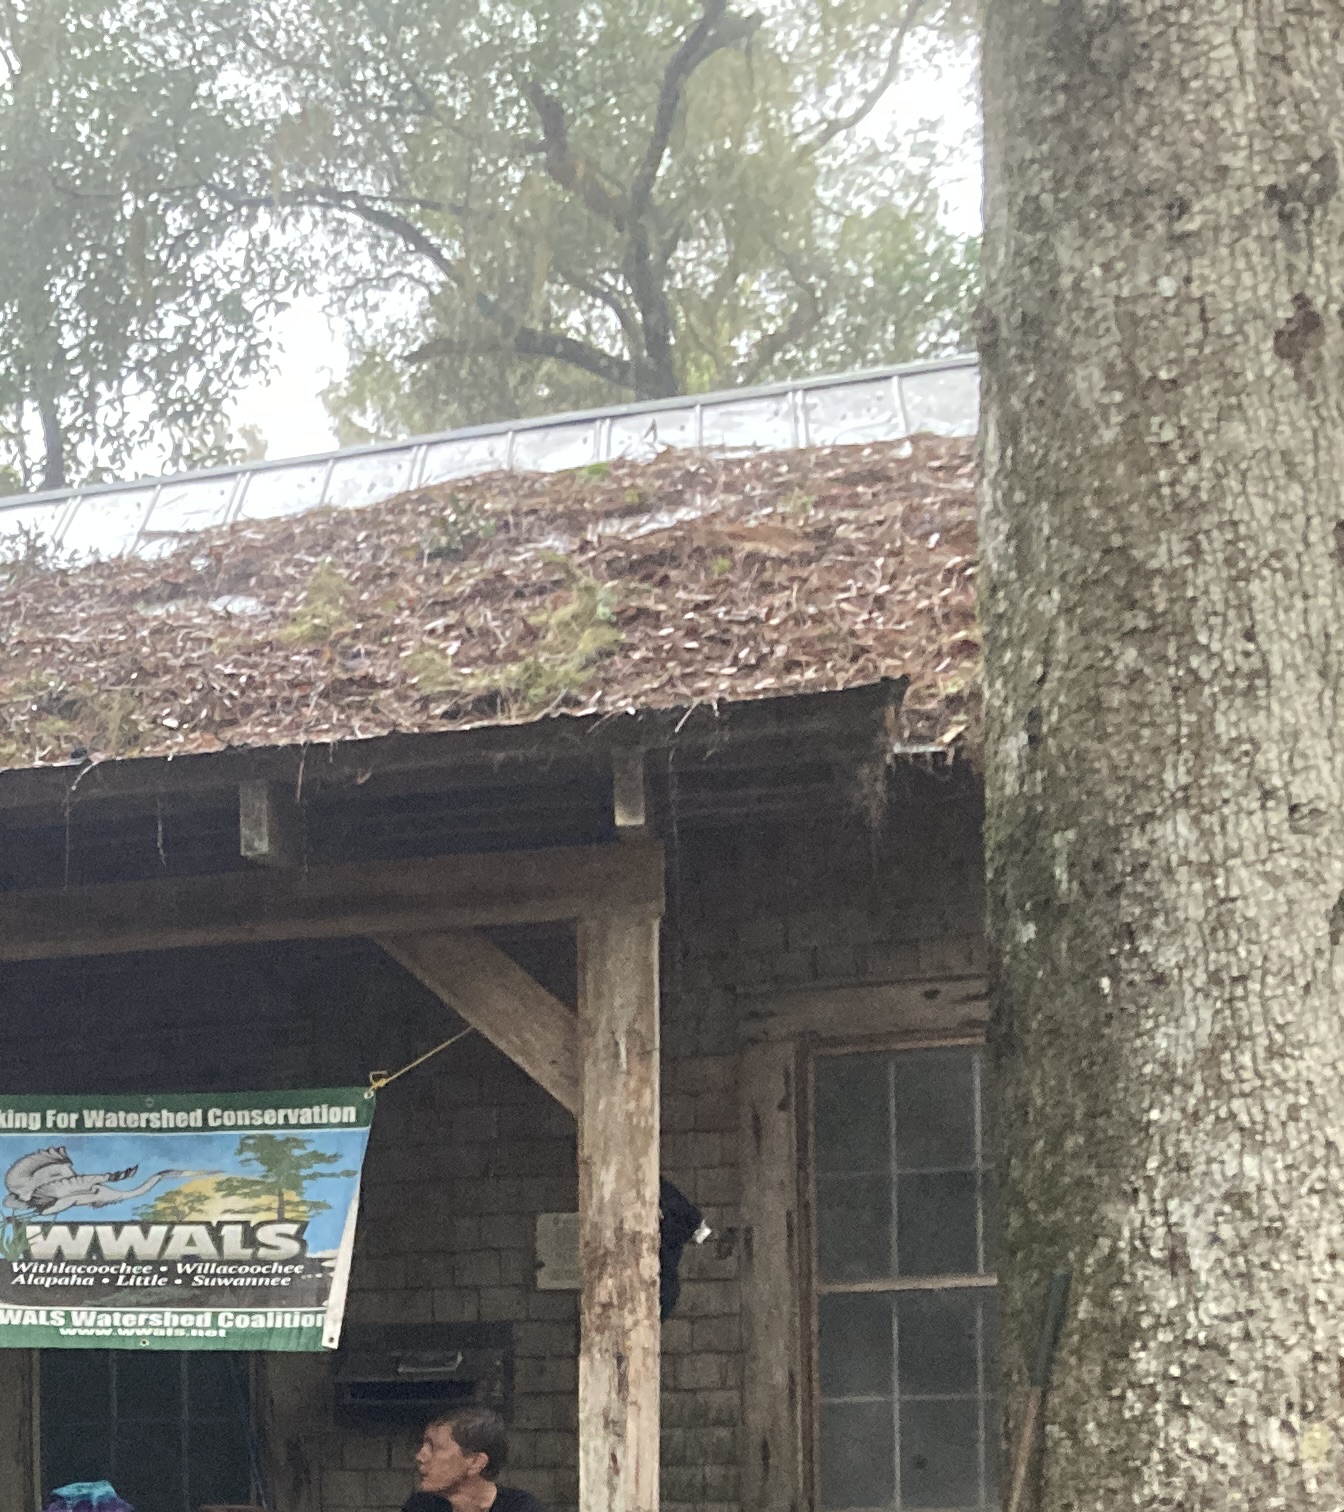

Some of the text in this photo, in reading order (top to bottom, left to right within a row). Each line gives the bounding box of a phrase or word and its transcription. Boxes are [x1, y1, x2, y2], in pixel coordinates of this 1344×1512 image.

[45, 1109, 79, 1129] For
[82, 1108, 203, 1129] Watershed
[207, 1104, 357, 1127] Conservation
[24, 1223, 302, 1260] WWALS
[12, 1261, 305, 1274] Withlacoochee Willacoochee
[11, 1274, 291, 1288] Alapaha Little Suwannee
[70, 1310, 212, 1328] Watershed
[58, 1327, 226, 1337] www.wwals.net
